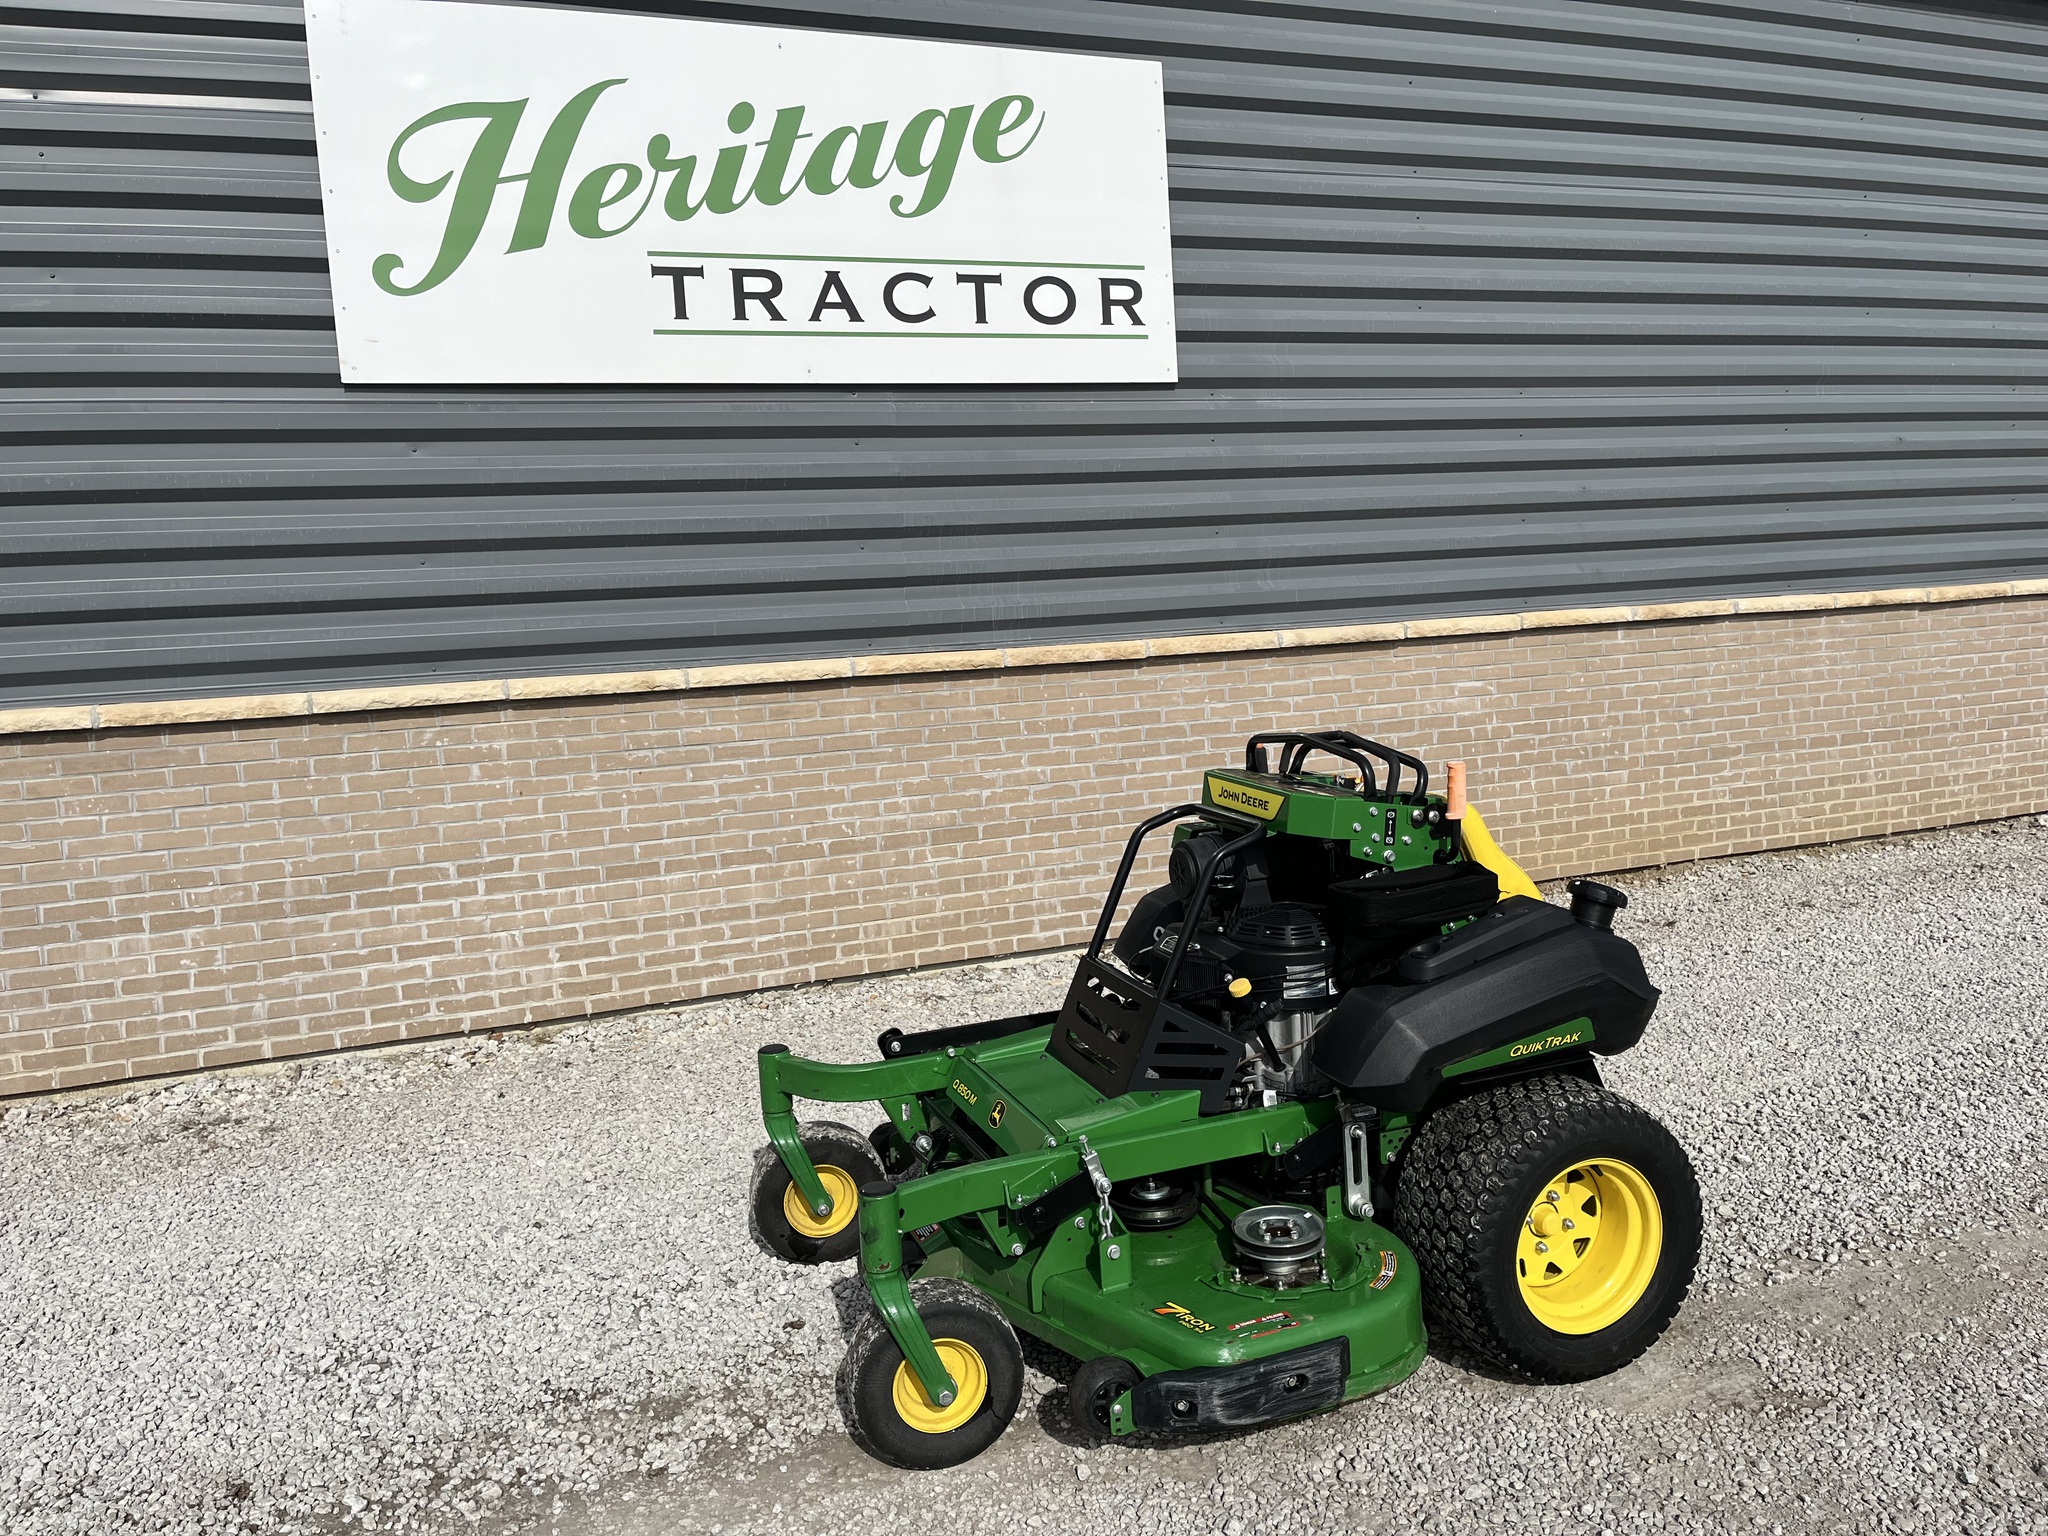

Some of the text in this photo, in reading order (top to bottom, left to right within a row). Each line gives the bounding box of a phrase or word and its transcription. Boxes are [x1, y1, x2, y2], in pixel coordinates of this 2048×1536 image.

[372, 78, 1045, 296] Heritage
[651, 263, 1146, 327] TRACTOR
[1218, 786, 1270, 812] JOHN DEERE
